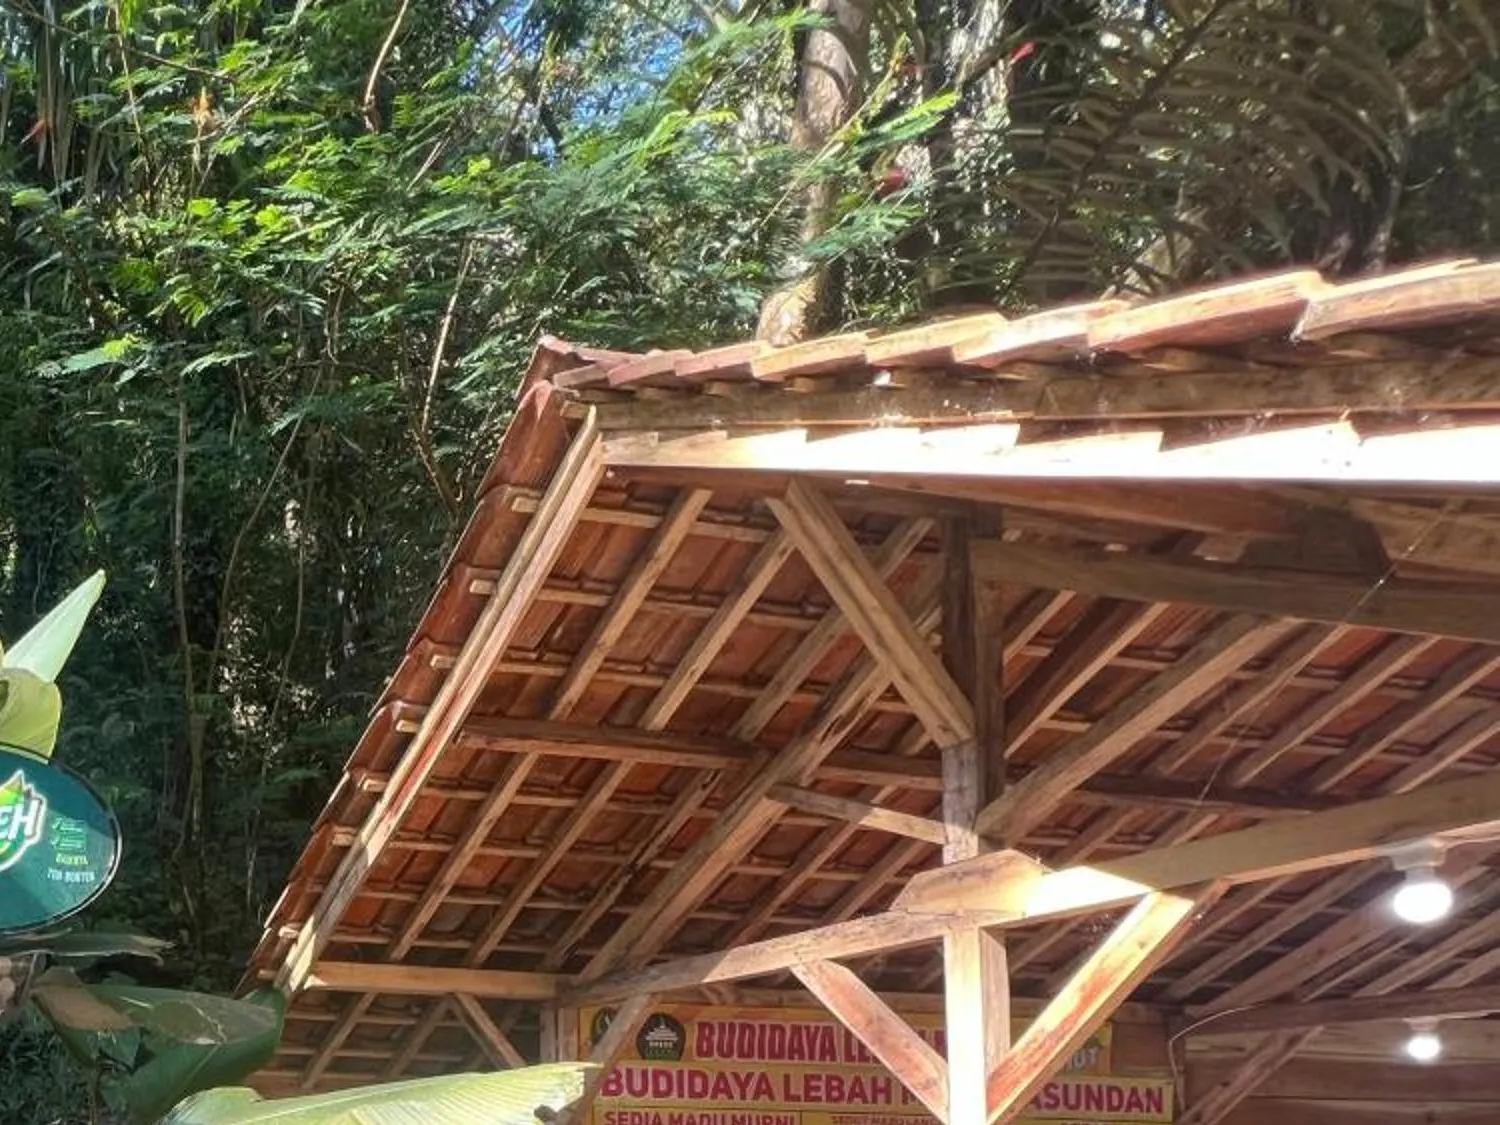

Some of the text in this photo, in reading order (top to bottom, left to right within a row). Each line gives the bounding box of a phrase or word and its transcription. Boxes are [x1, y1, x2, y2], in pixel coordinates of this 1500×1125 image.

[696, 1021, 838, 1063] BUDIDAYA
[600, 1067, 775, 1101] BUDIDAYA
[783, 1073, 892, 1104] LEBAH
[1030, 1082, 1163, 1114] ASUNDAN
